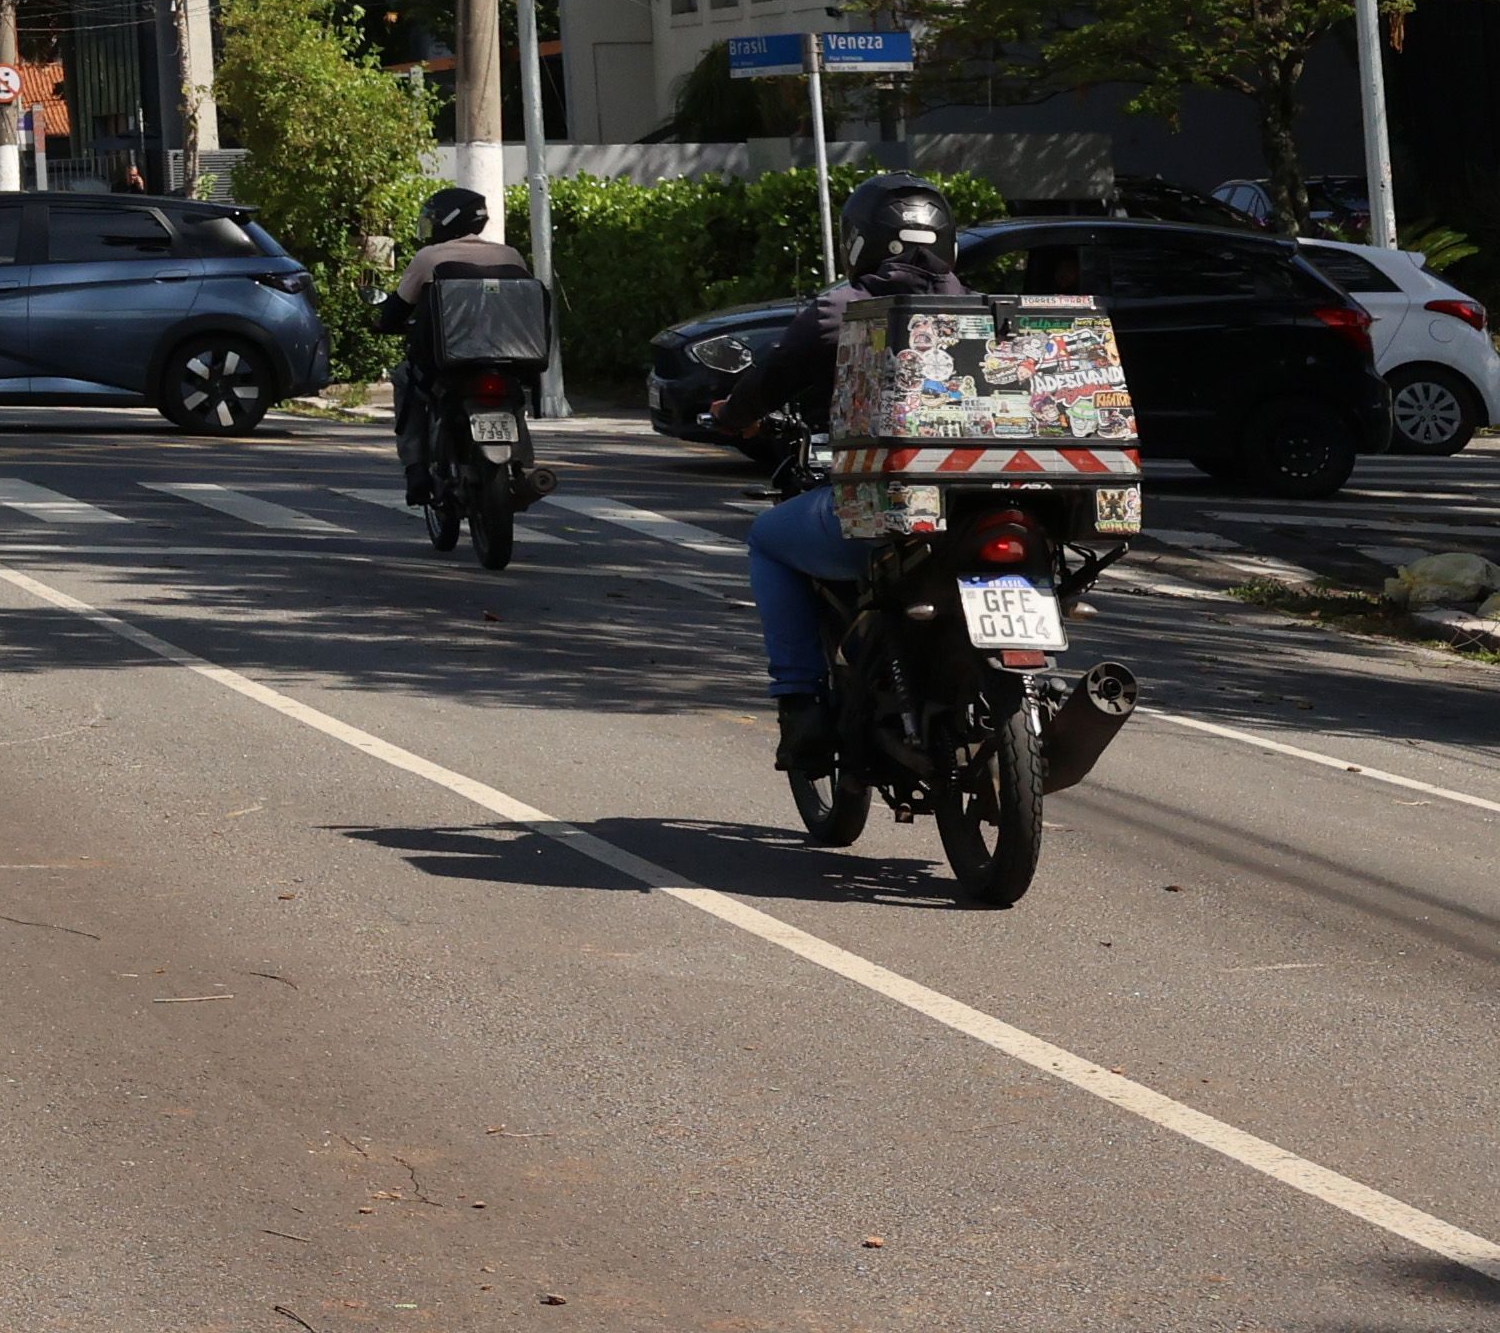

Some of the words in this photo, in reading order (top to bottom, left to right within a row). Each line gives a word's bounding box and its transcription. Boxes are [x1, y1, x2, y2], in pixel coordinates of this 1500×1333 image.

[729, 38, 768, 56] Brasil
[827, 34, 884, 50] Veneza
[479, 421, 510, 431] EXE
[988, 580, 1025, 588] BRASIL
[983, 590, 1037, 614] GFE
